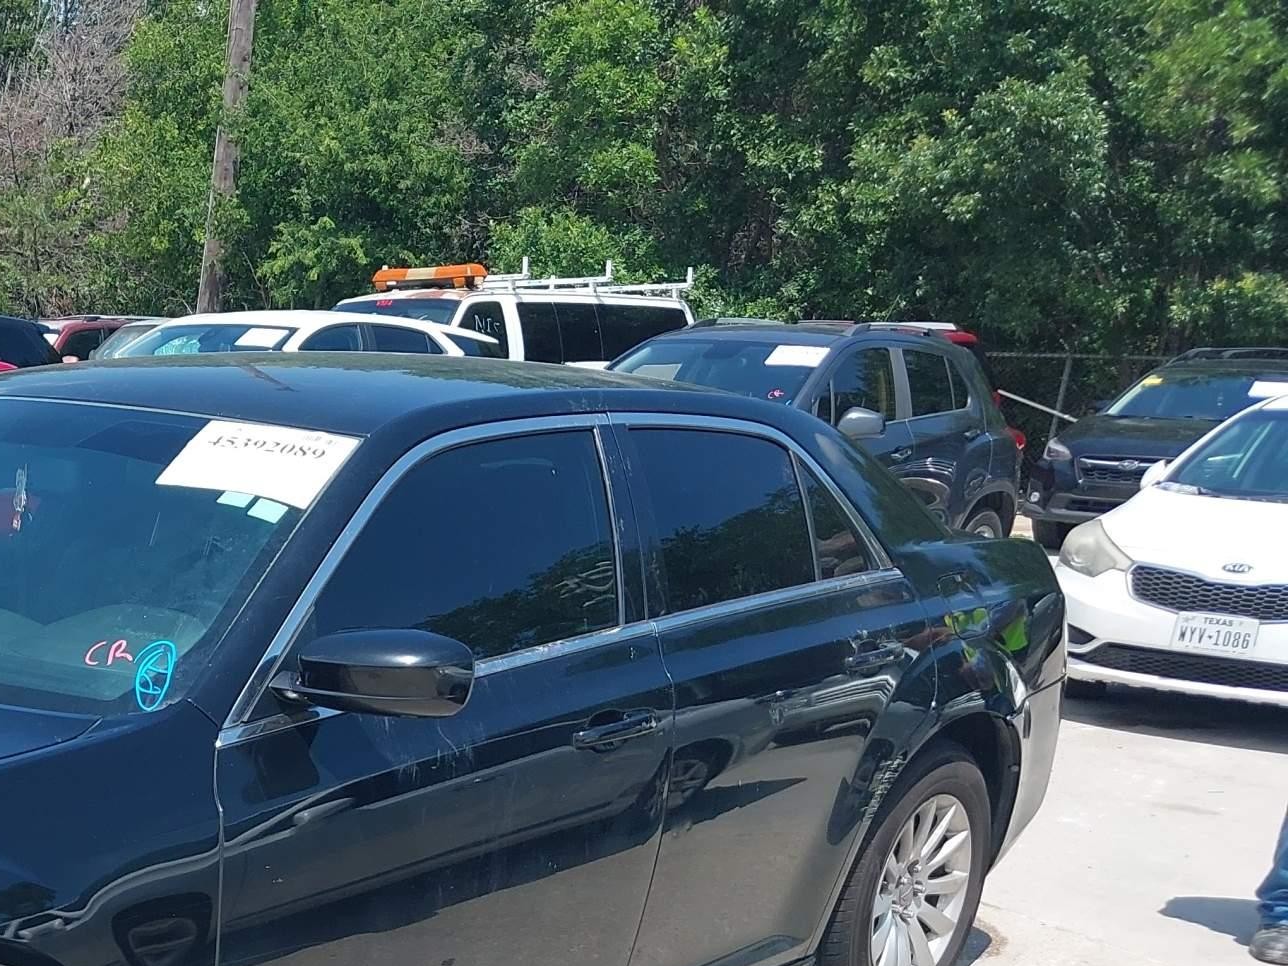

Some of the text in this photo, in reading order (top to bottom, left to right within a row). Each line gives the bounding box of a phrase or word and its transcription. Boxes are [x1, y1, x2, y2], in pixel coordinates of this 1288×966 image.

[208, 436, 326, 459] 45392089
[1204, 616, 1234, 627] TEXAS
[85, 639, 133, 666] CR
